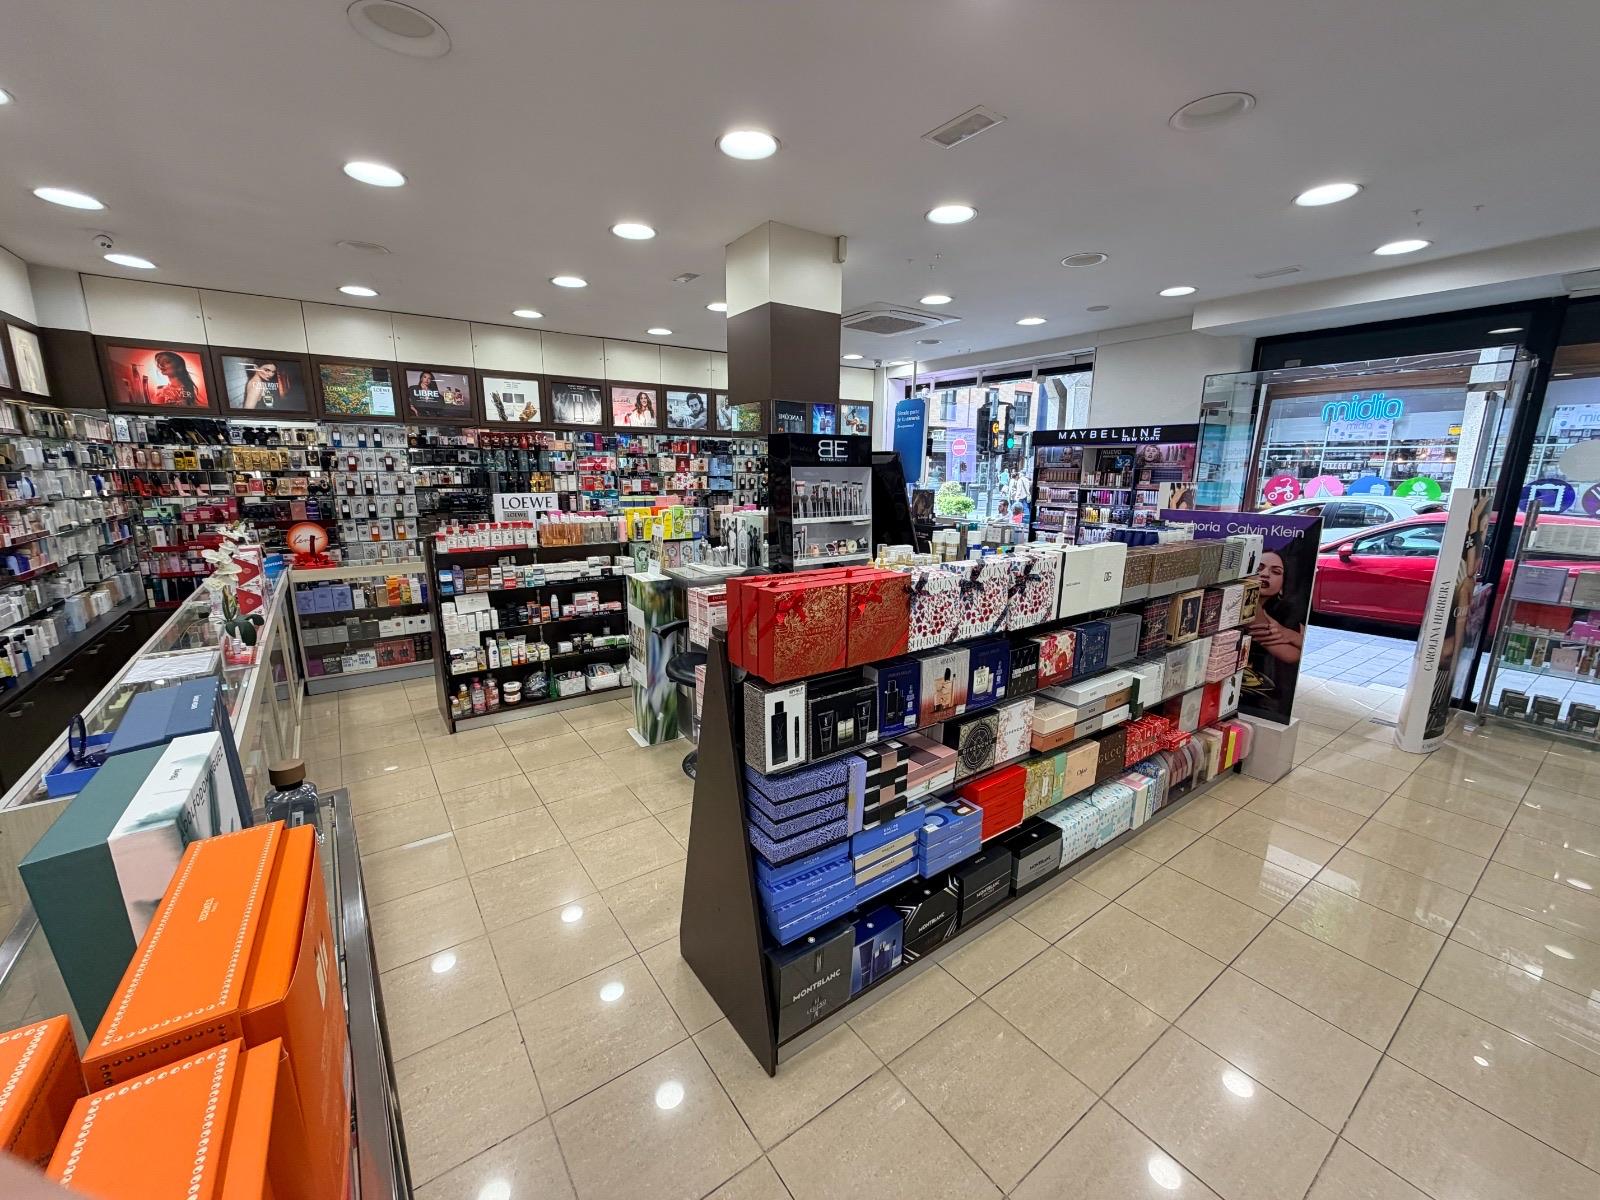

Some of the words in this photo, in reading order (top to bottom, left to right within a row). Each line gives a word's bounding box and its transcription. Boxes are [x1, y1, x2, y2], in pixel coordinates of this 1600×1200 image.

[413, 389, 439, 398] LIBRE
[1321, 393, 1403, 423] midia
[1058, 427, 1162, 440] MAYBELLINE
[1346, 421, 1373, 430] midia
[501, 496, 553, 509] LOEWE
[1191, 520, 1220, 532] horia
[1226, 522, 1268, 536] Calvin
[1271, 525, 1305, 539] Klein
[1423, 627, 1441, 672] CAROLINA
[1433, 581, 1451, 625] HERRERA
[1098, 743, 1124, 763] GUCCI
[976, 880, 1000, 898] MONTBLANC
[918, 911, 945, 932] MONTBLANC
[793, 968, 841, 1002] MONTBLANC
